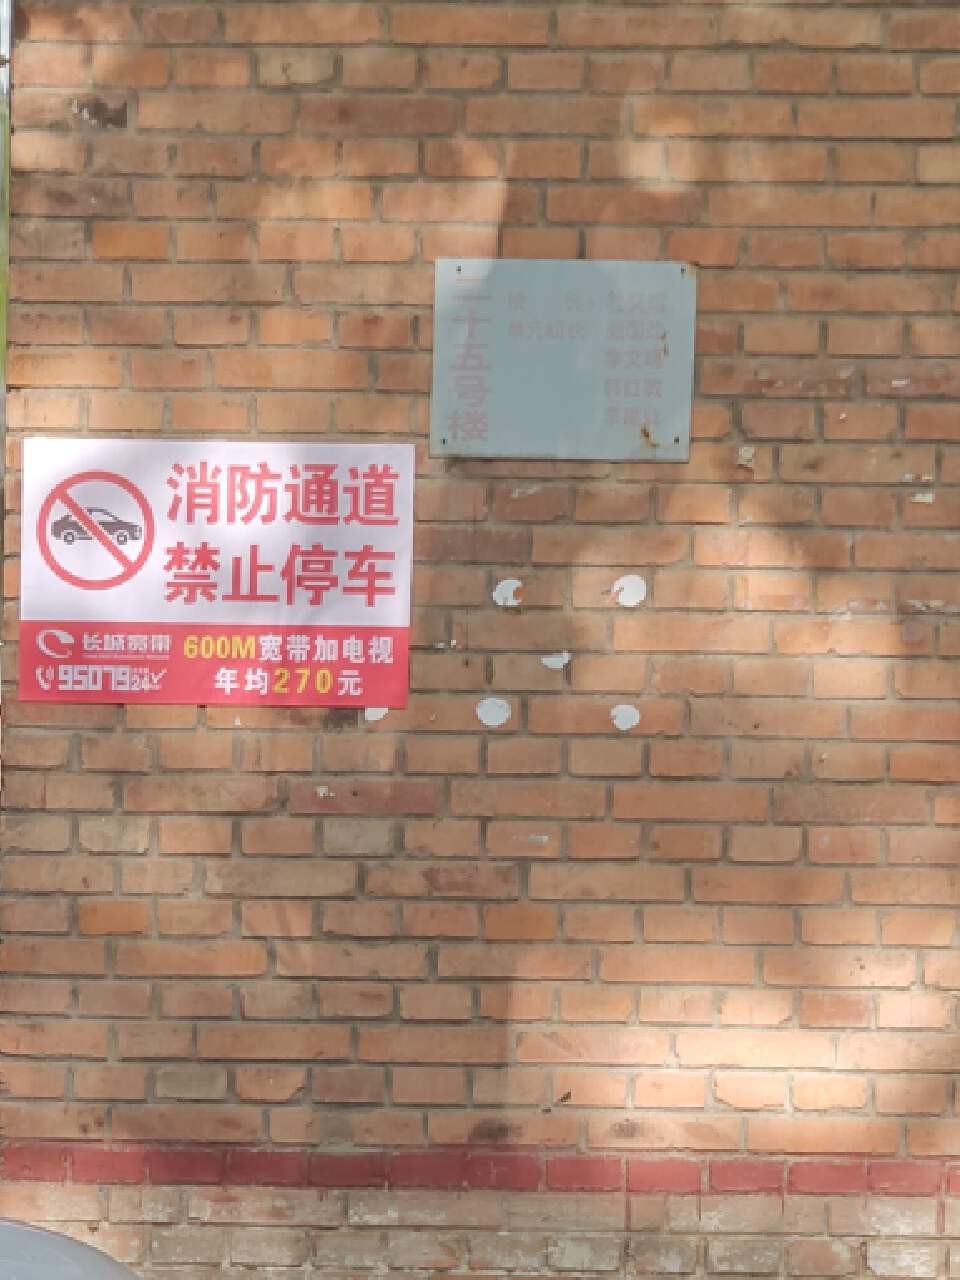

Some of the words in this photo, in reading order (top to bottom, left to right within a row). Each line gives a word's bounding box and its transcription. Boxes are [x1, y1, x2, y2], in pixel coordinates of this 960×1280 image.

[164, 461, 401, 527] 消防通道
[163, 540, 397, 608] 禁止停车
[183, 634, 394, 665] 600M宽带加电视
[214, 667, 364, 697] 年均270元
